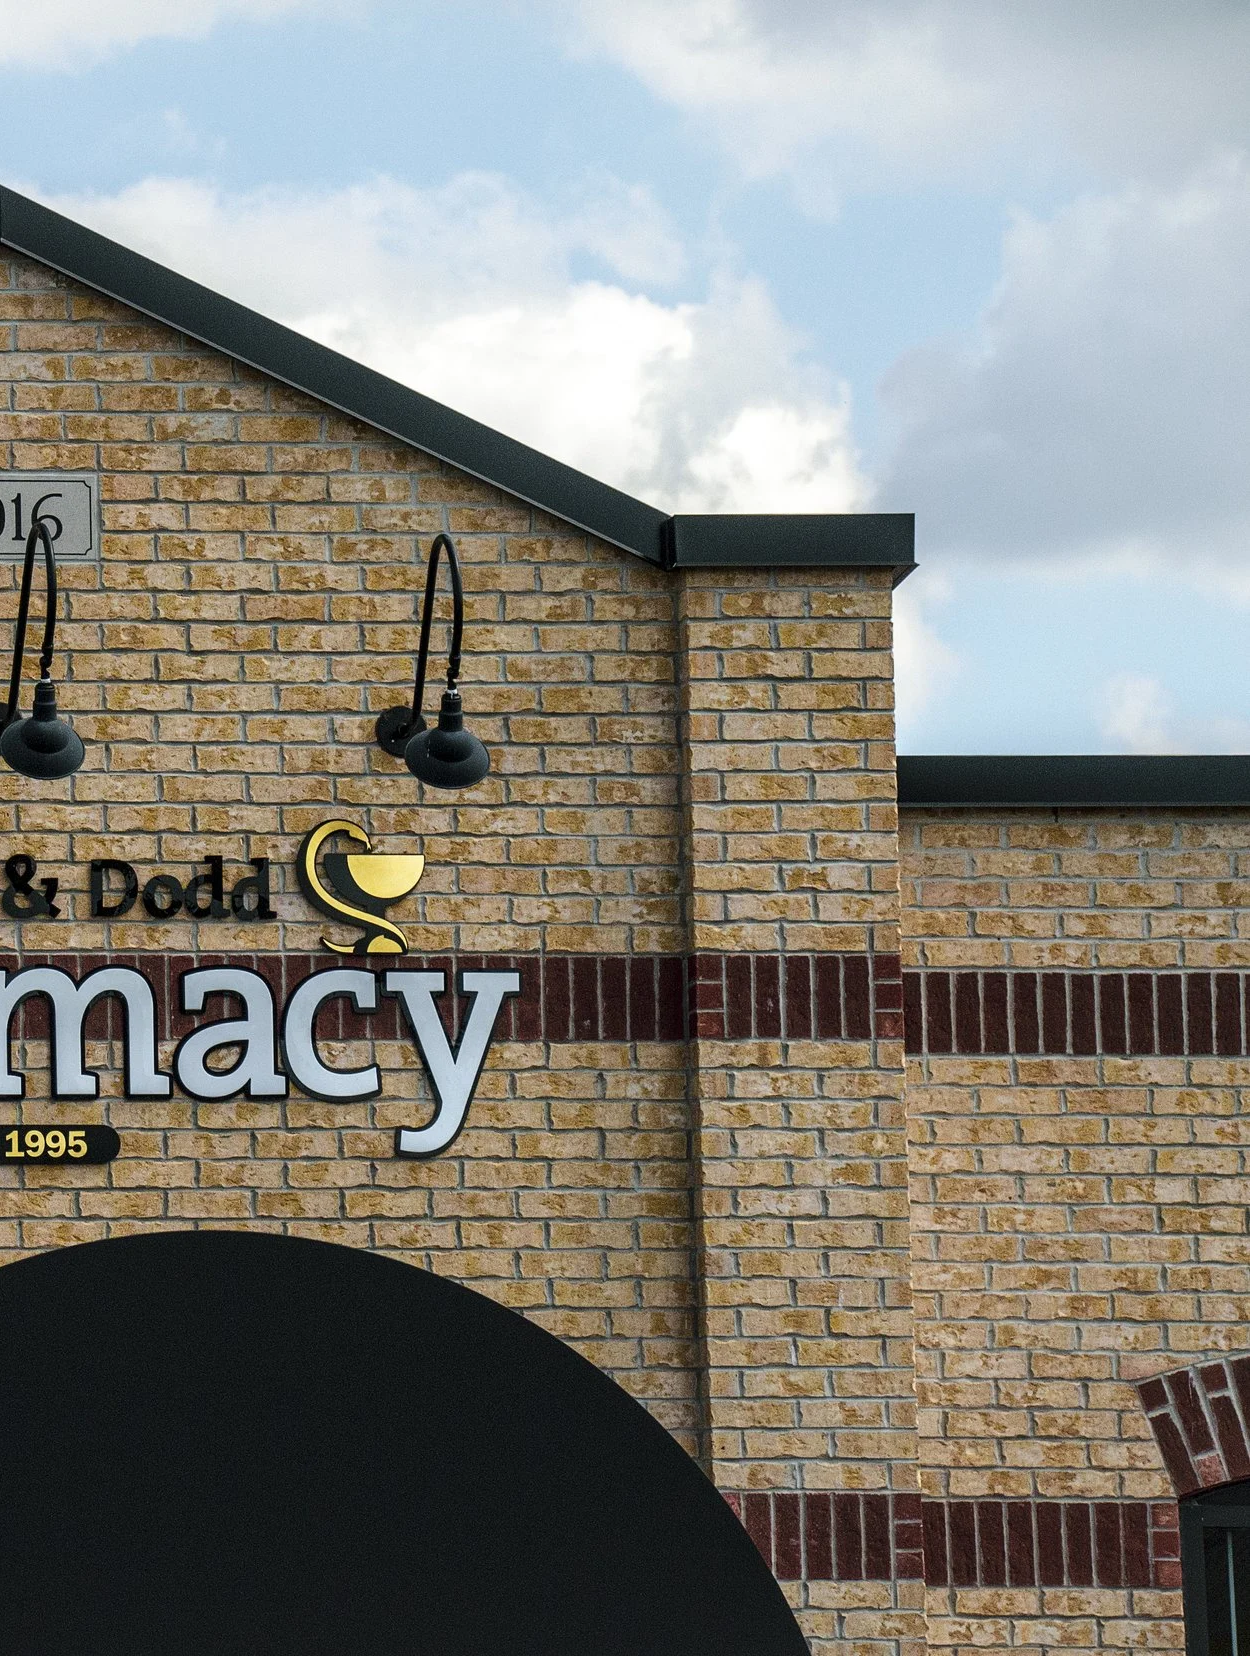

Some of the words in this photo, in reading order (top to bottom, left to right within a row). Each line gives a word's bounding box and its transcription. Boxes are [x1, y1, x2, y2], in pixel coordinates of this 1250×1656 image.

[1, 853, 62, 919] &
[93, 855, 277, 921] Dodd
[5, 1130, 88, 1158] 1995
